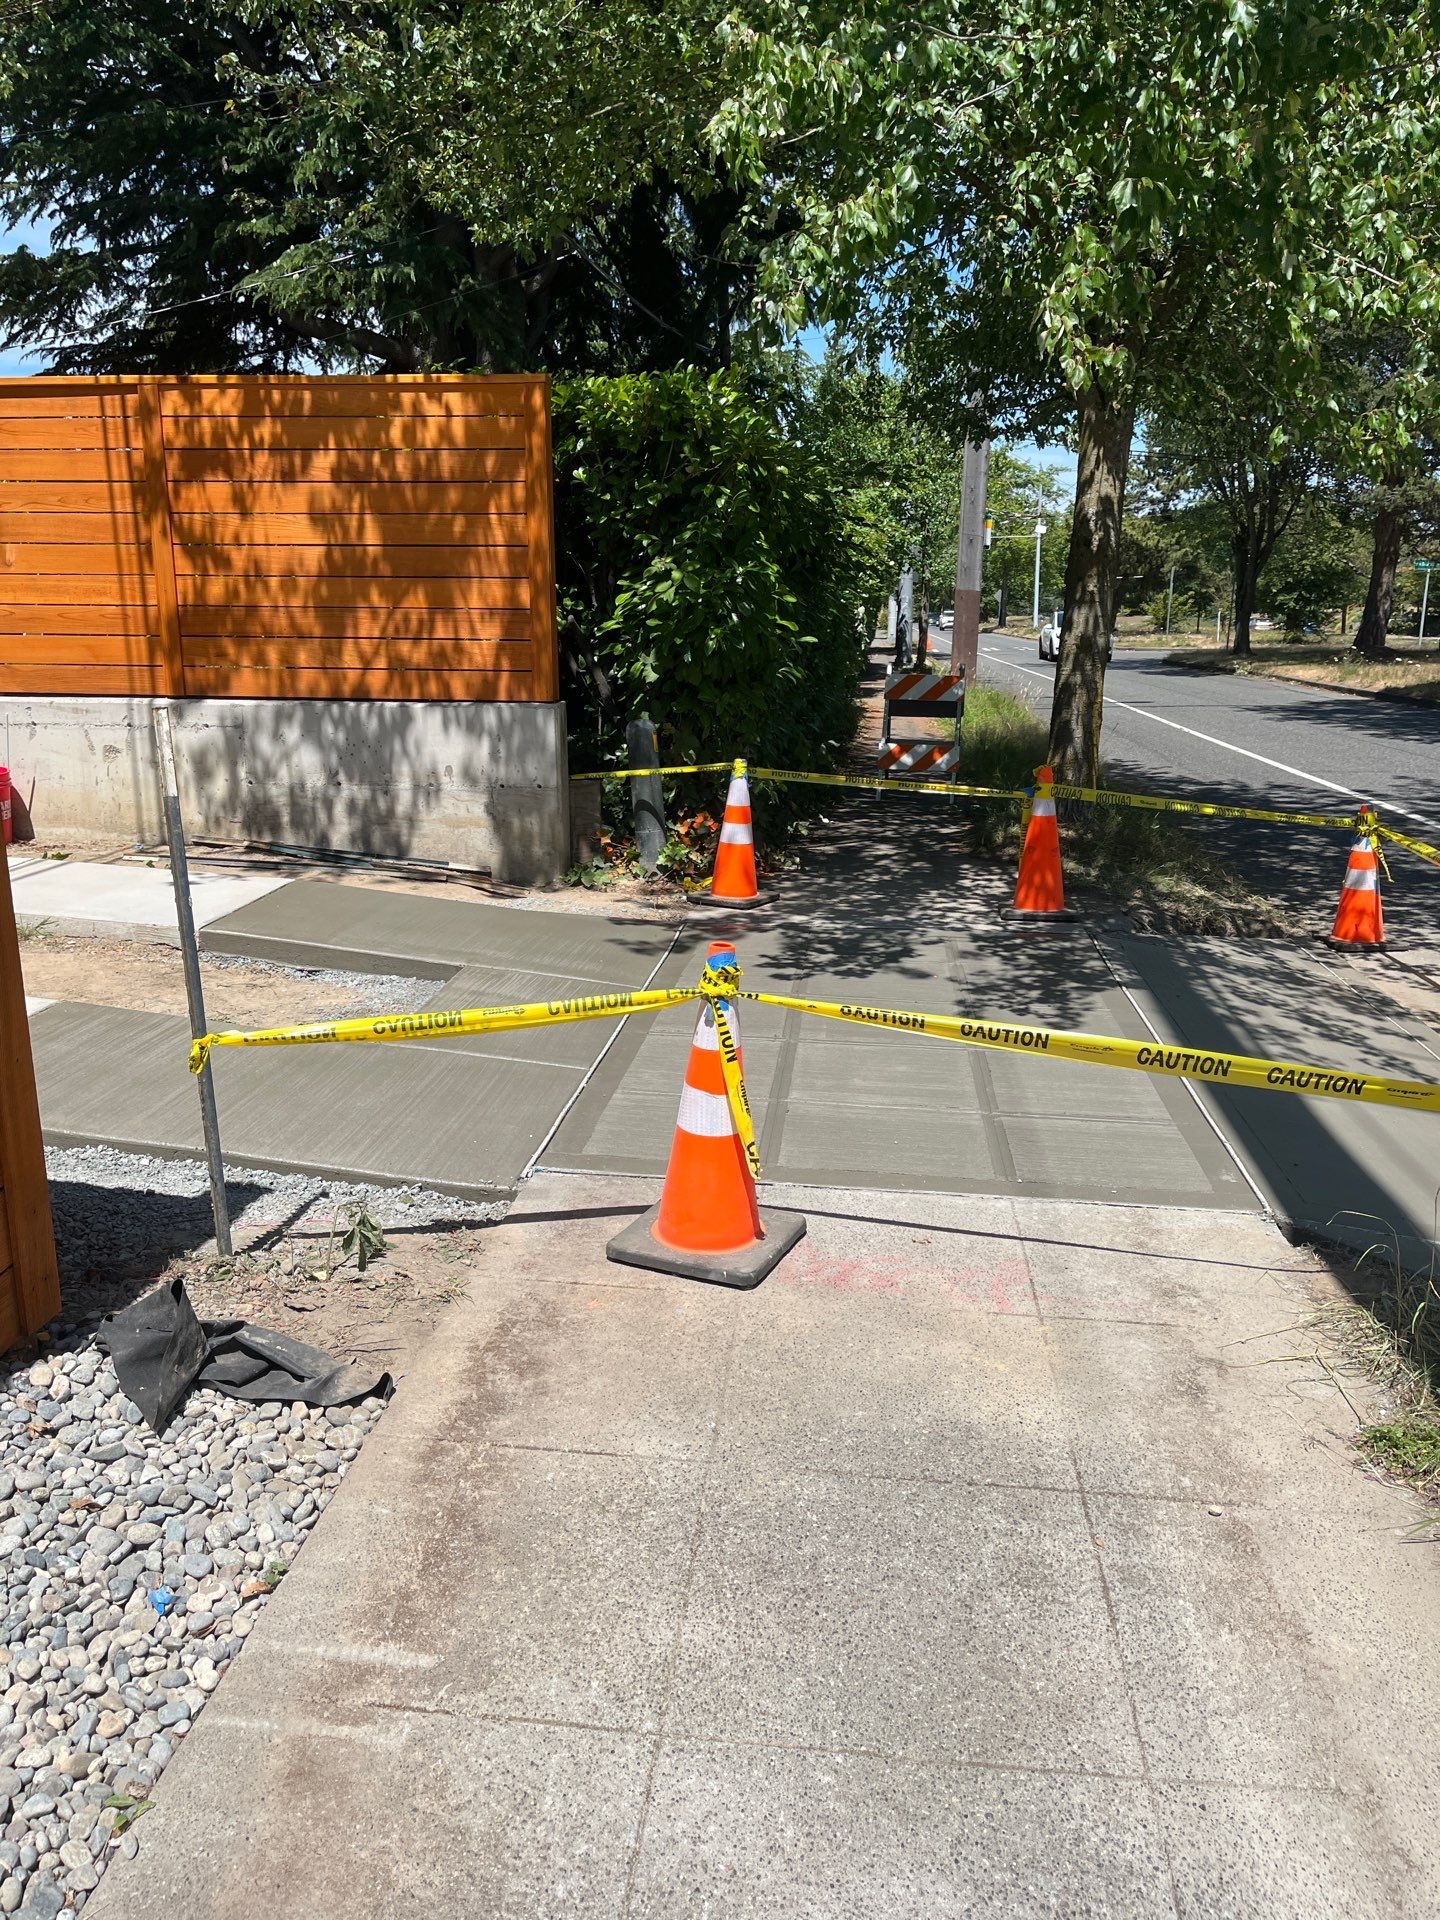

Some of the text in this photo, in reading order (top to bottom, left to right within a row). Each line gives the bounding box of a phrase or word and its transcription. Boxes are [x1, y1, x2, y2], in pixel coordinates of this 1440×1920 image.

[960, 1021, 1049, 1049] CAUTION
[1137, 1047, 1232, 1077] CAUTION
[1266, 1066, 1367, 1096] CAUTION
